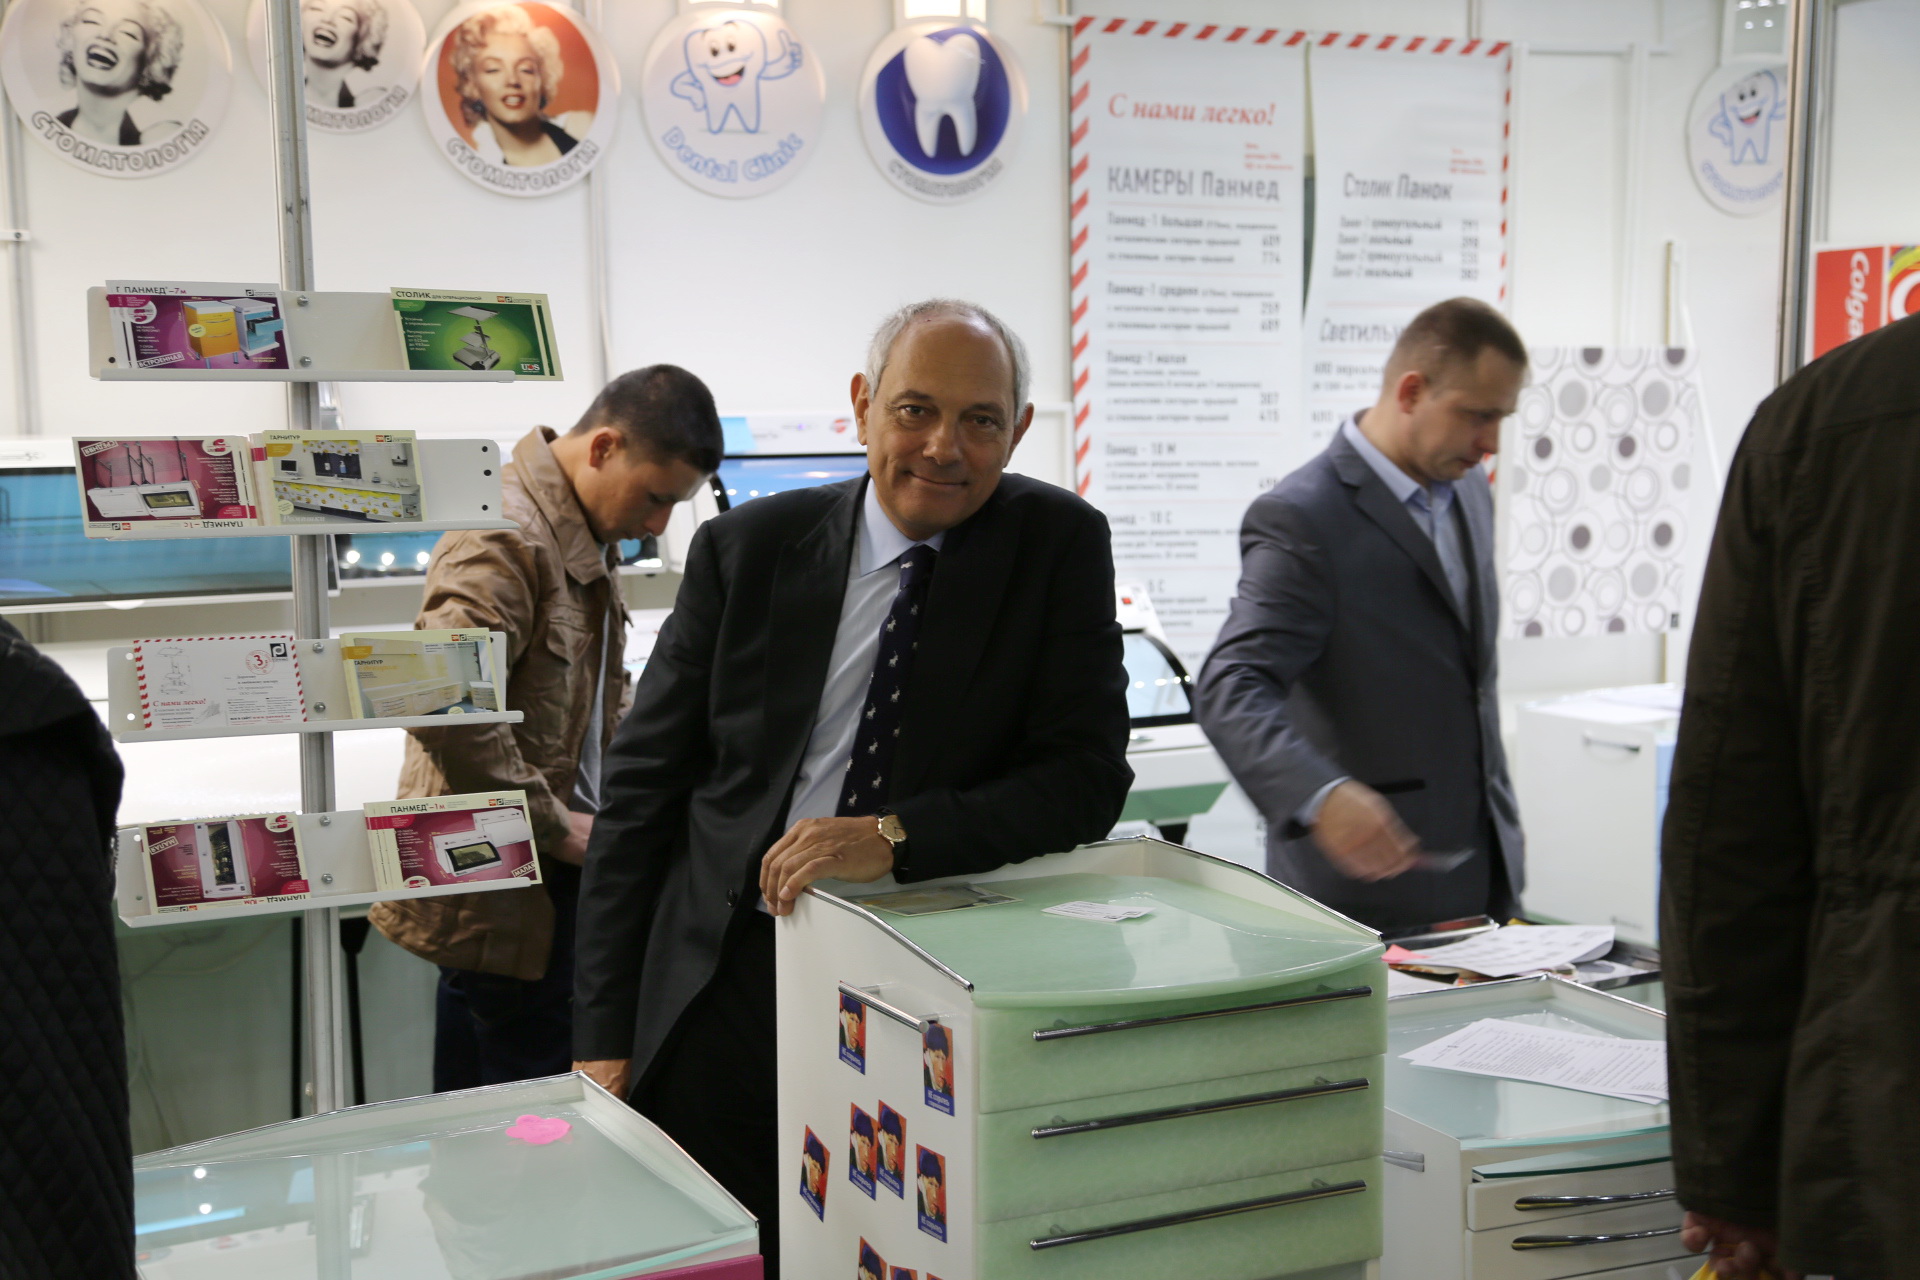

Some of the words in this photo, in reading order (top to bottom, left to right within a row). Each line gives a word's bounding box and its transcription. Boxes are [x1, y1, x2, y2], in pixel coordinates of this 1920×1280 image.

[306, 85, 409, 129] МАТОЛОГІЯ
[1132, 101, 1195, 123] нами
[1201, 102, 1276, 126] легко!
[662, 125, 738, 183] Dental
[741, 132, 805, 182] Clinic
[1107, 166, 1195, 196] КАМЕРЫ
[1201, 170, 1280, 201] Панмед
[1344, 171, 1393, 199] Столик
[1396, 173, 1453, 200] Панок
[396, 290, 431, 299] СТОЛИК
[1845, 250, 1870, 341] Colga
[390, 803, 428, 813] ПАНМЕД
